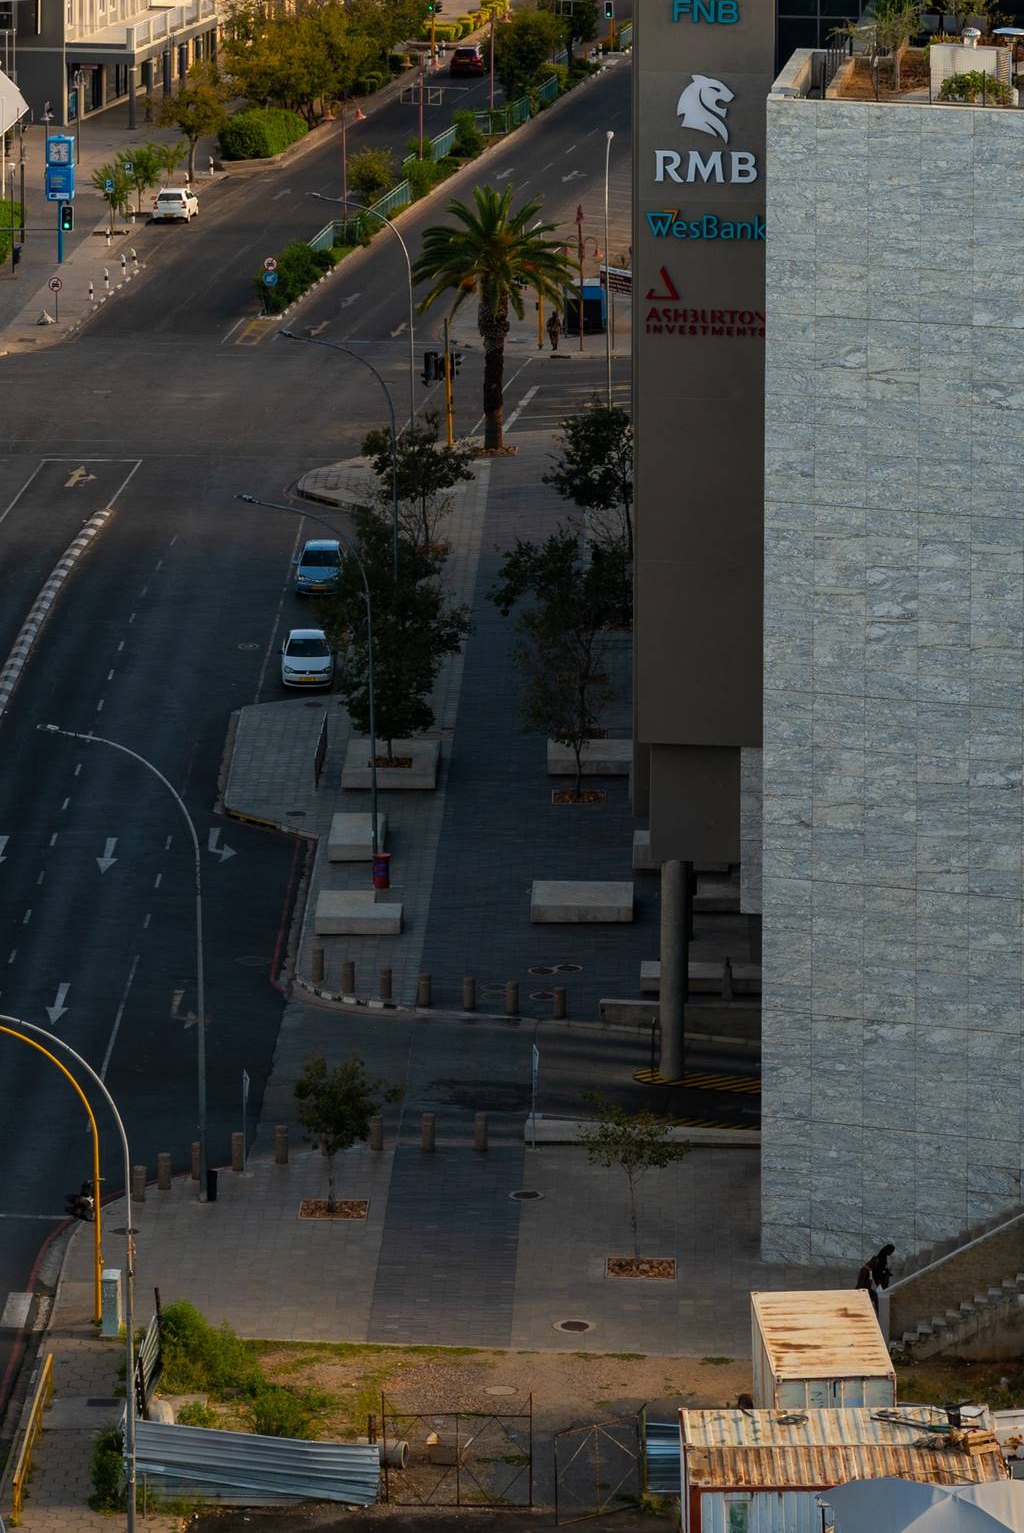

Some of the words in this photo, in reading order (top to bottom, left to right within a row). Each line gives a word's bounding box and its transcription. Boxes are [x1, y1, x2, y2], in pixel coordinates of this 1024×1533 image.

[654, 150, 758, 184] RMB
[646, 211, 766, 241] WesBank
[646, 324, 766, 338] INVESTMENTS
